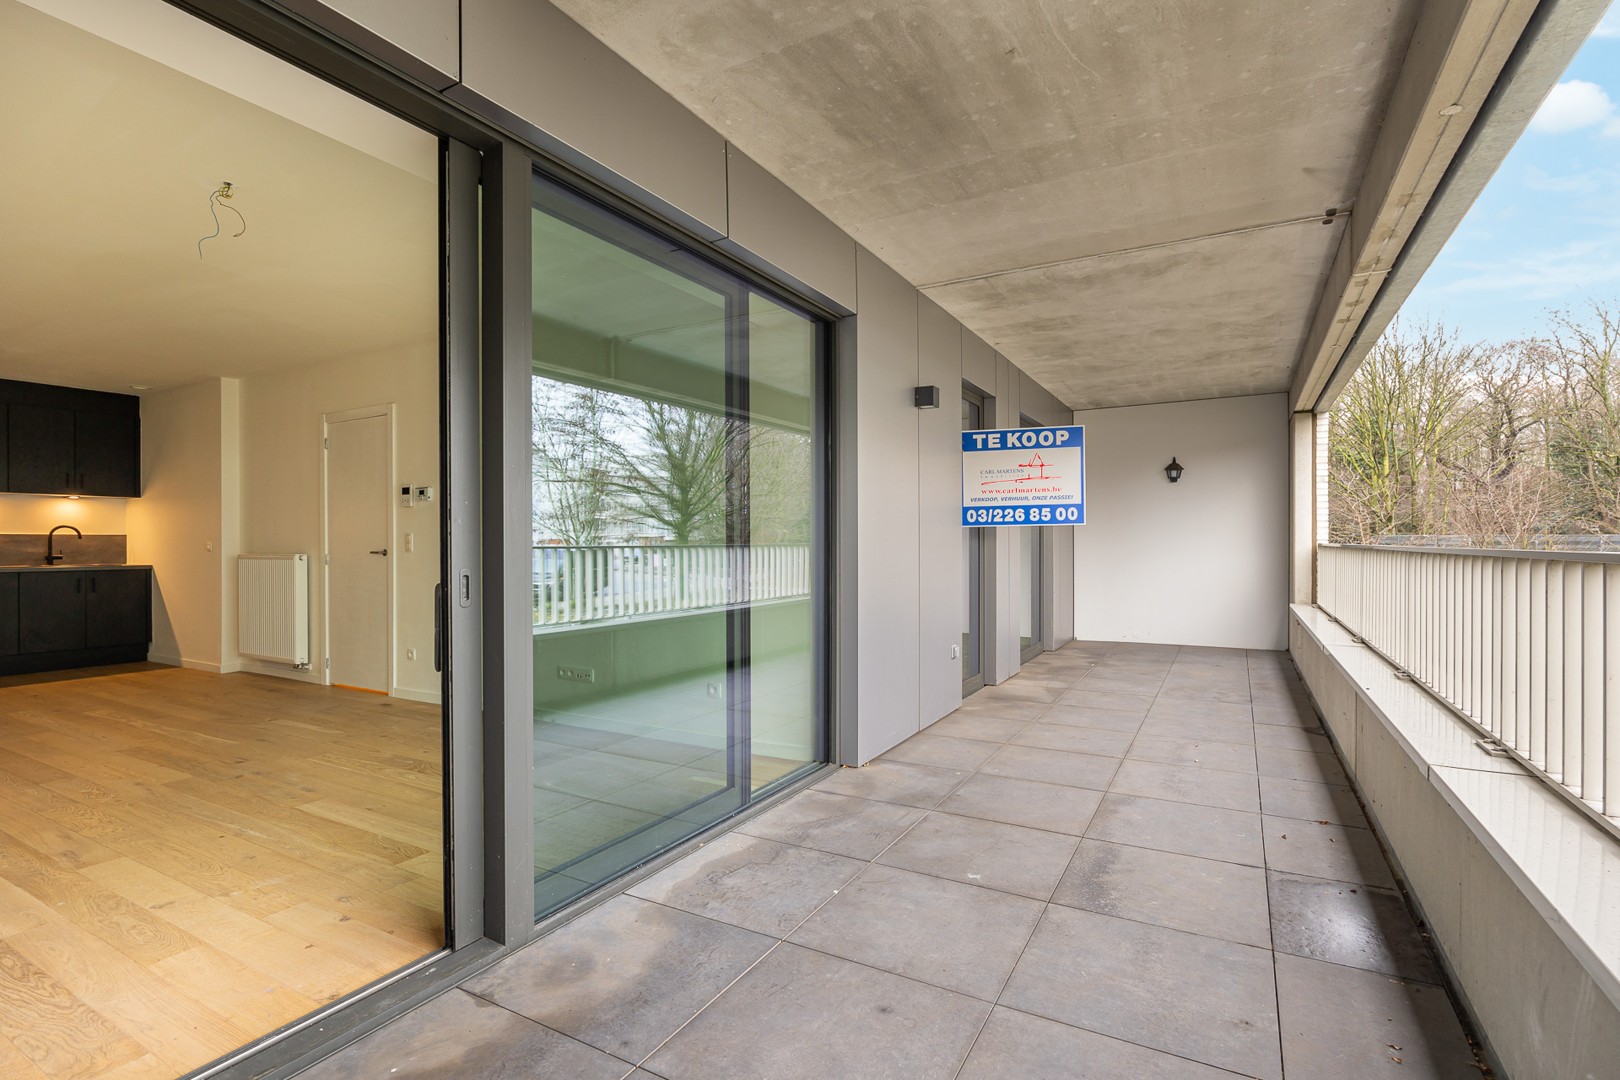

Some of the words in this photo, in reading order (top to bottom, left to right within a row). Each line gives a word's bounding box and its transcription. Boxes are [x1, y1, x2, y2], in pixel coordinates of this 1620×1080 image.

[973, 433, 1001, 449] TE
[1007, 430, 1070, 448] KOOP
[981, 486, 1062, 495] www.carlmartens.be
[966, 508, 1025, 523] 03/226
[1029, 507, 1051, 521] 85
[1055, 506, 1078, 521] 00
